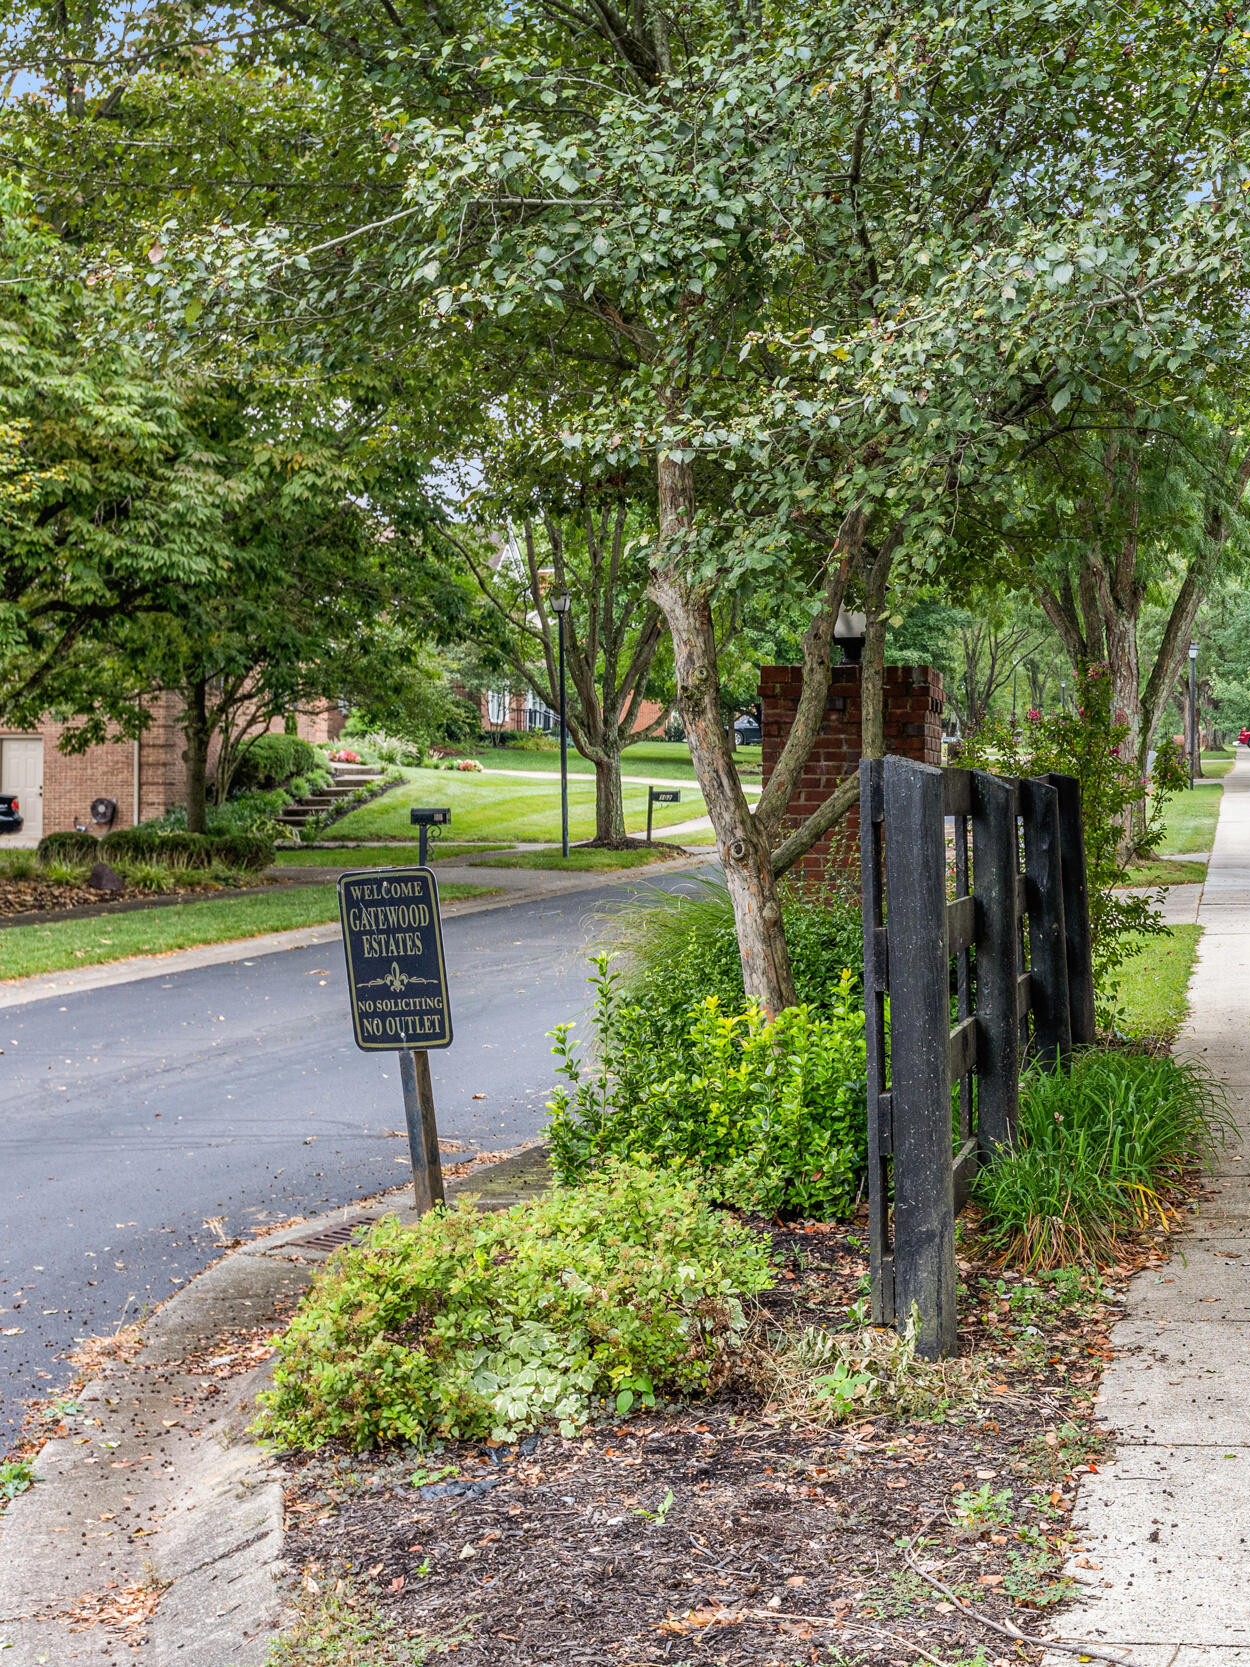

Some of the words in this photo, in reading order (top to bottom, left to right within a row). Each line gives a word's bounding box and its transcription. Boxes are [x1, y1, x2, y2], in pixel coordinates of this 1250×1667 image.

[350, 881, 424, 900] WELCOME
[349, 904, 430, 931] GATEWOOD
[362, 932, 423, 958] ESTATES
[358, 1000, 374, 1013] NO
[376, 997, 443, 1012] SOLICITING
[363, 1018, 383, 1036] NO
[386, 1015, 441, 1036] OUTLET
